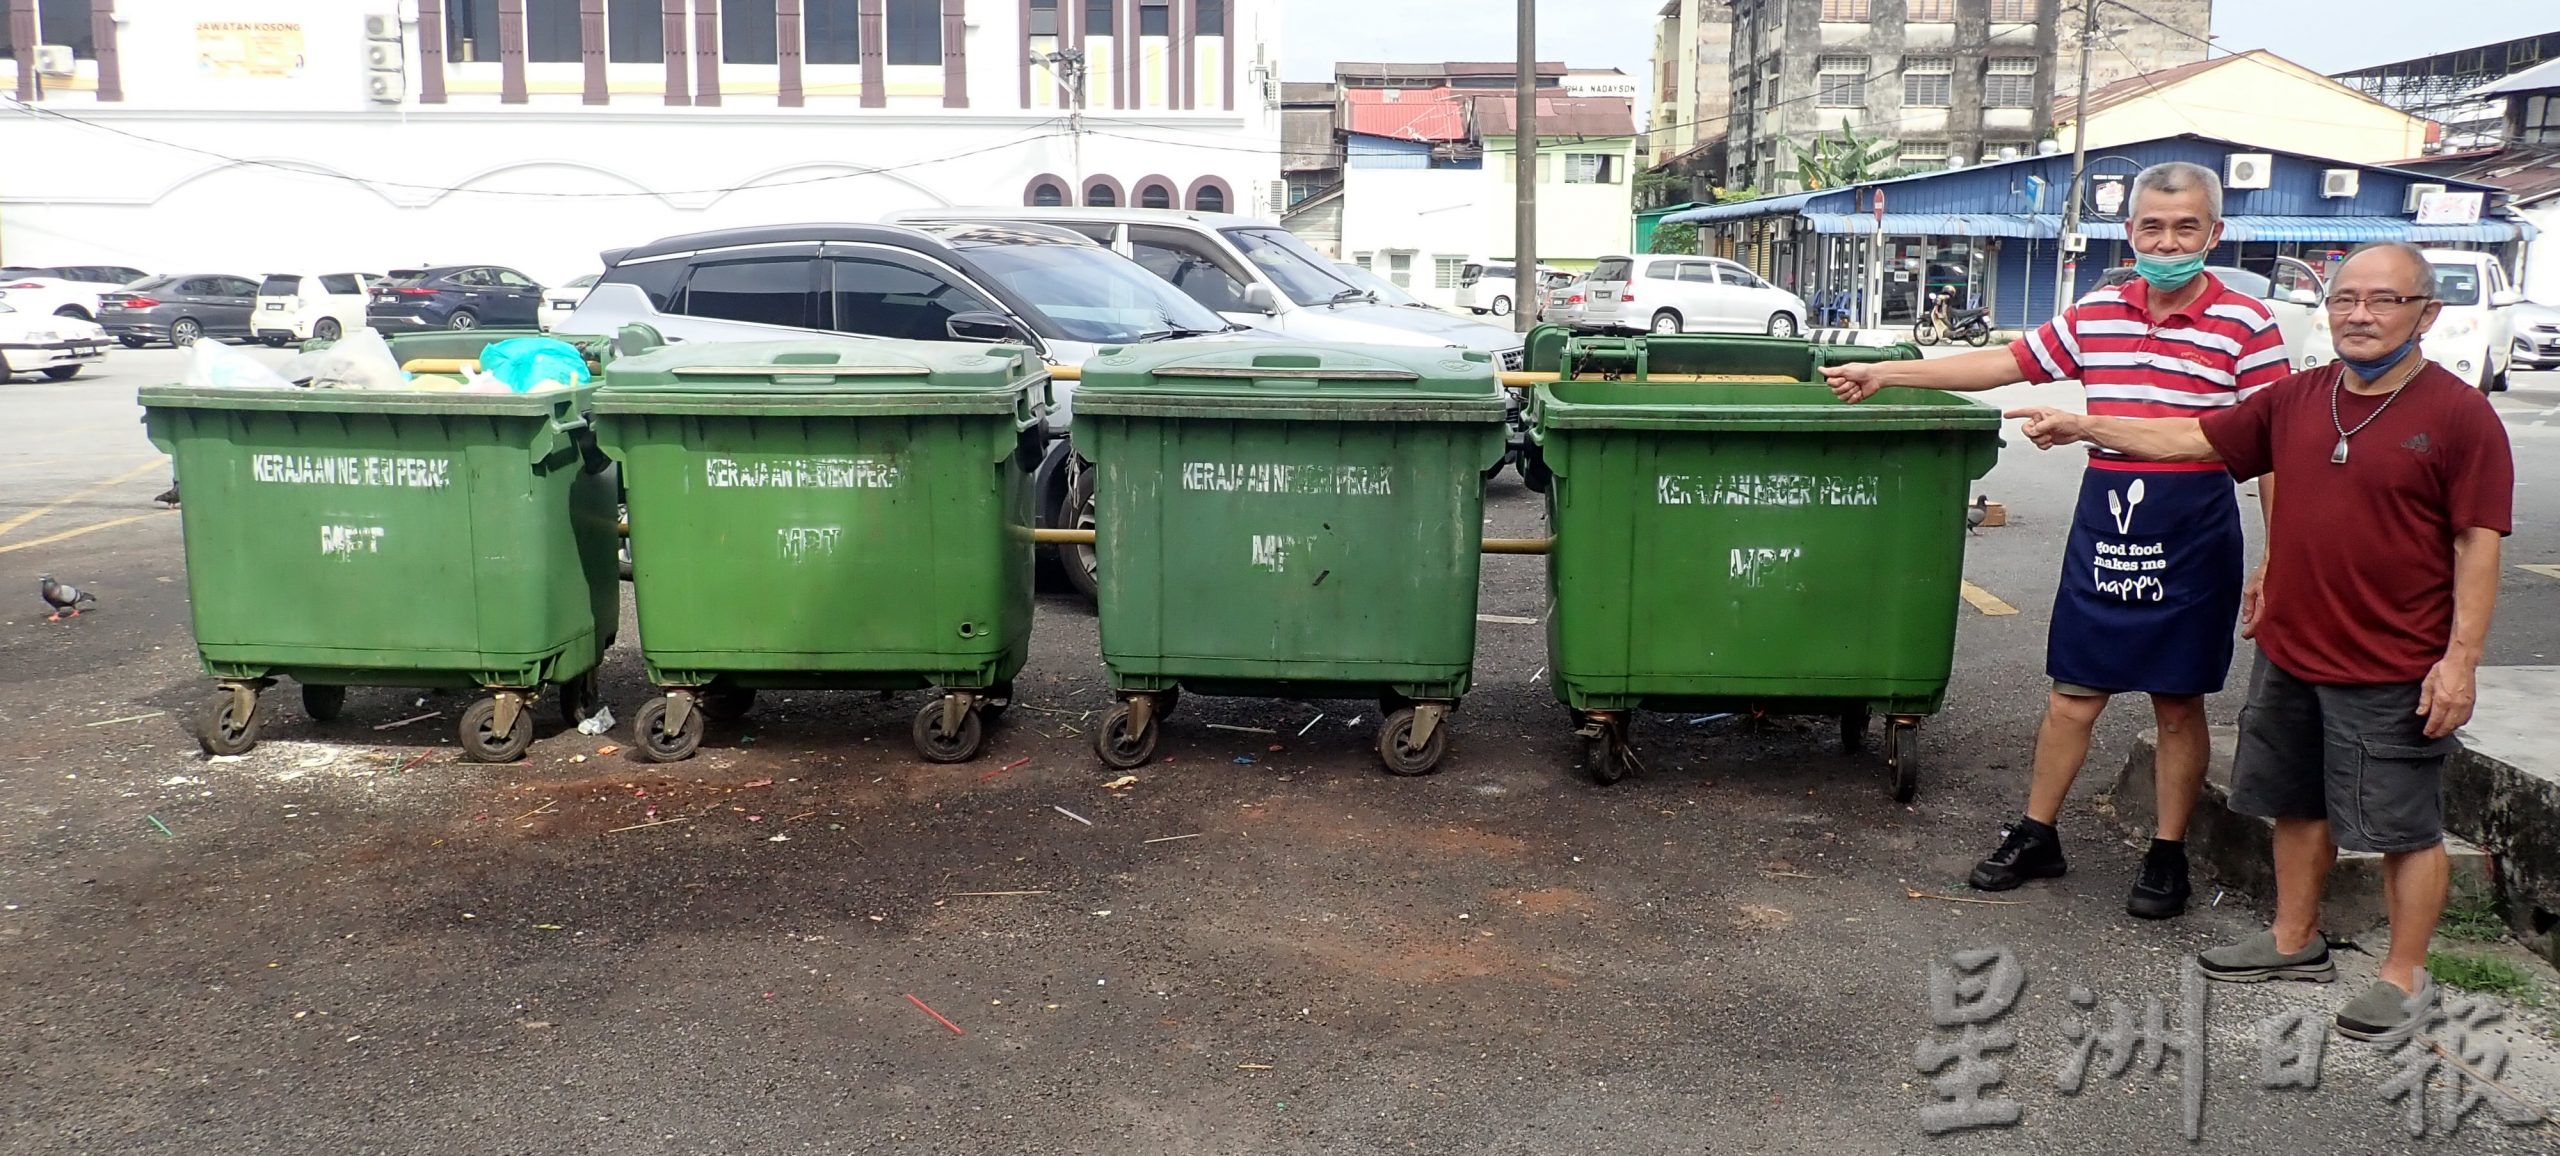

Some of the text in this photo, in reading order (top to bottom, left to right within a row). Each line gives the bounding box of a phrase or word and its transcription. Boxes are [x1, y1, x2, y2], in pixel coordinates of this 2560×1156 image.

[197, 22, 300, 31] JAWATAN KOSONG
[1591, 85, 1635, 93] NADAYSON
[253, 454, 335, 484] KERAJAAN
[398, 458, 449, 487] PERAK
[707, 458, 793, 487] KERAJAAN
[857, 460, 904, 488] PERA
[1183, 462, 1392, 495] KERAJAAN NEI PERAK
[1820, 476, 1878, 505] PERAK
[2095, 541, 2163, 556] good food
[2093, 556, 2166, 571] makes me
[2094, 567, 2163, 601] happy
